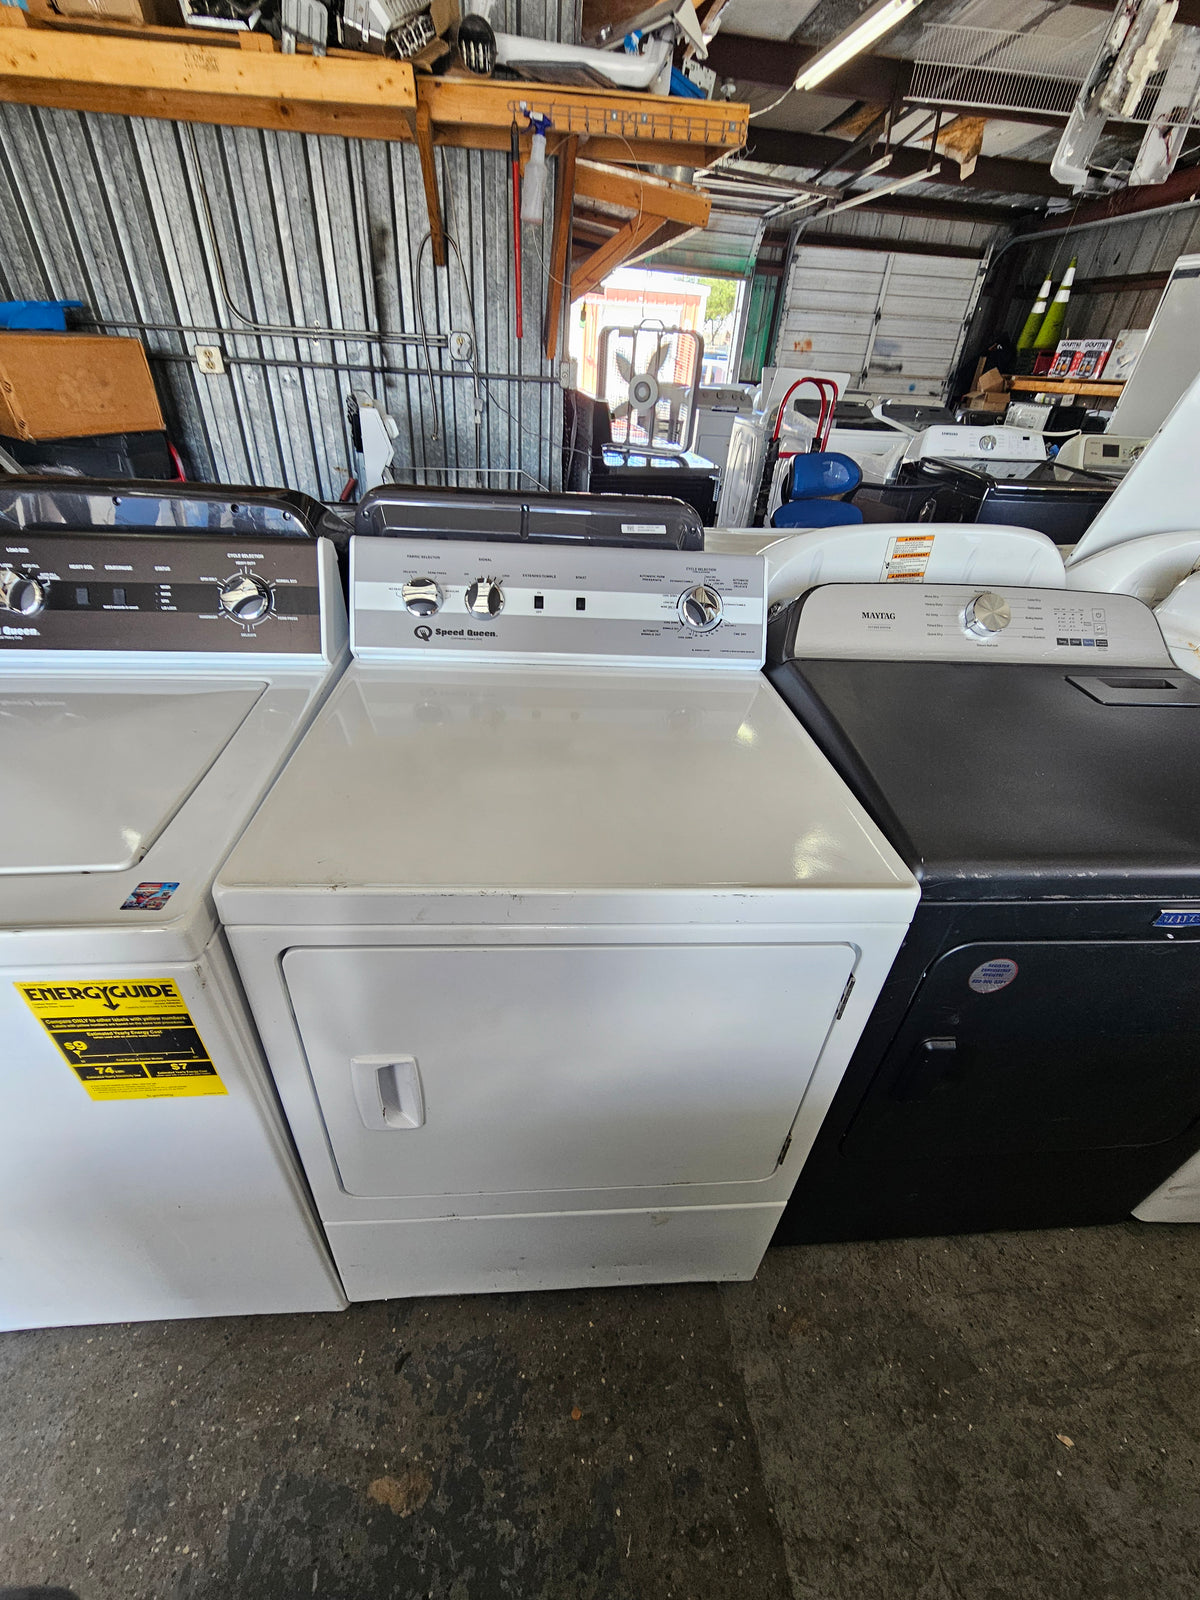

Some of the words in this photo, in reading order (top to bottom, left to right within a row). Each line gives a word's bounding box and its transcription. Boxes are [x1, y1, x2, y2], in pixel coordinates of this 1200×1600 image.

[861, 611, 896, 620] MAYTAG
[435, 628, 464, 639] Speed
[23, 984, 178, 1002] ENERGYGUIDE
[45, 1018, 71, 1026] Compare
[63, 1040, 88, 1051] $9
[94, 1067, 115, 1075] 74
[169, 1063, 188, 1071] $7
